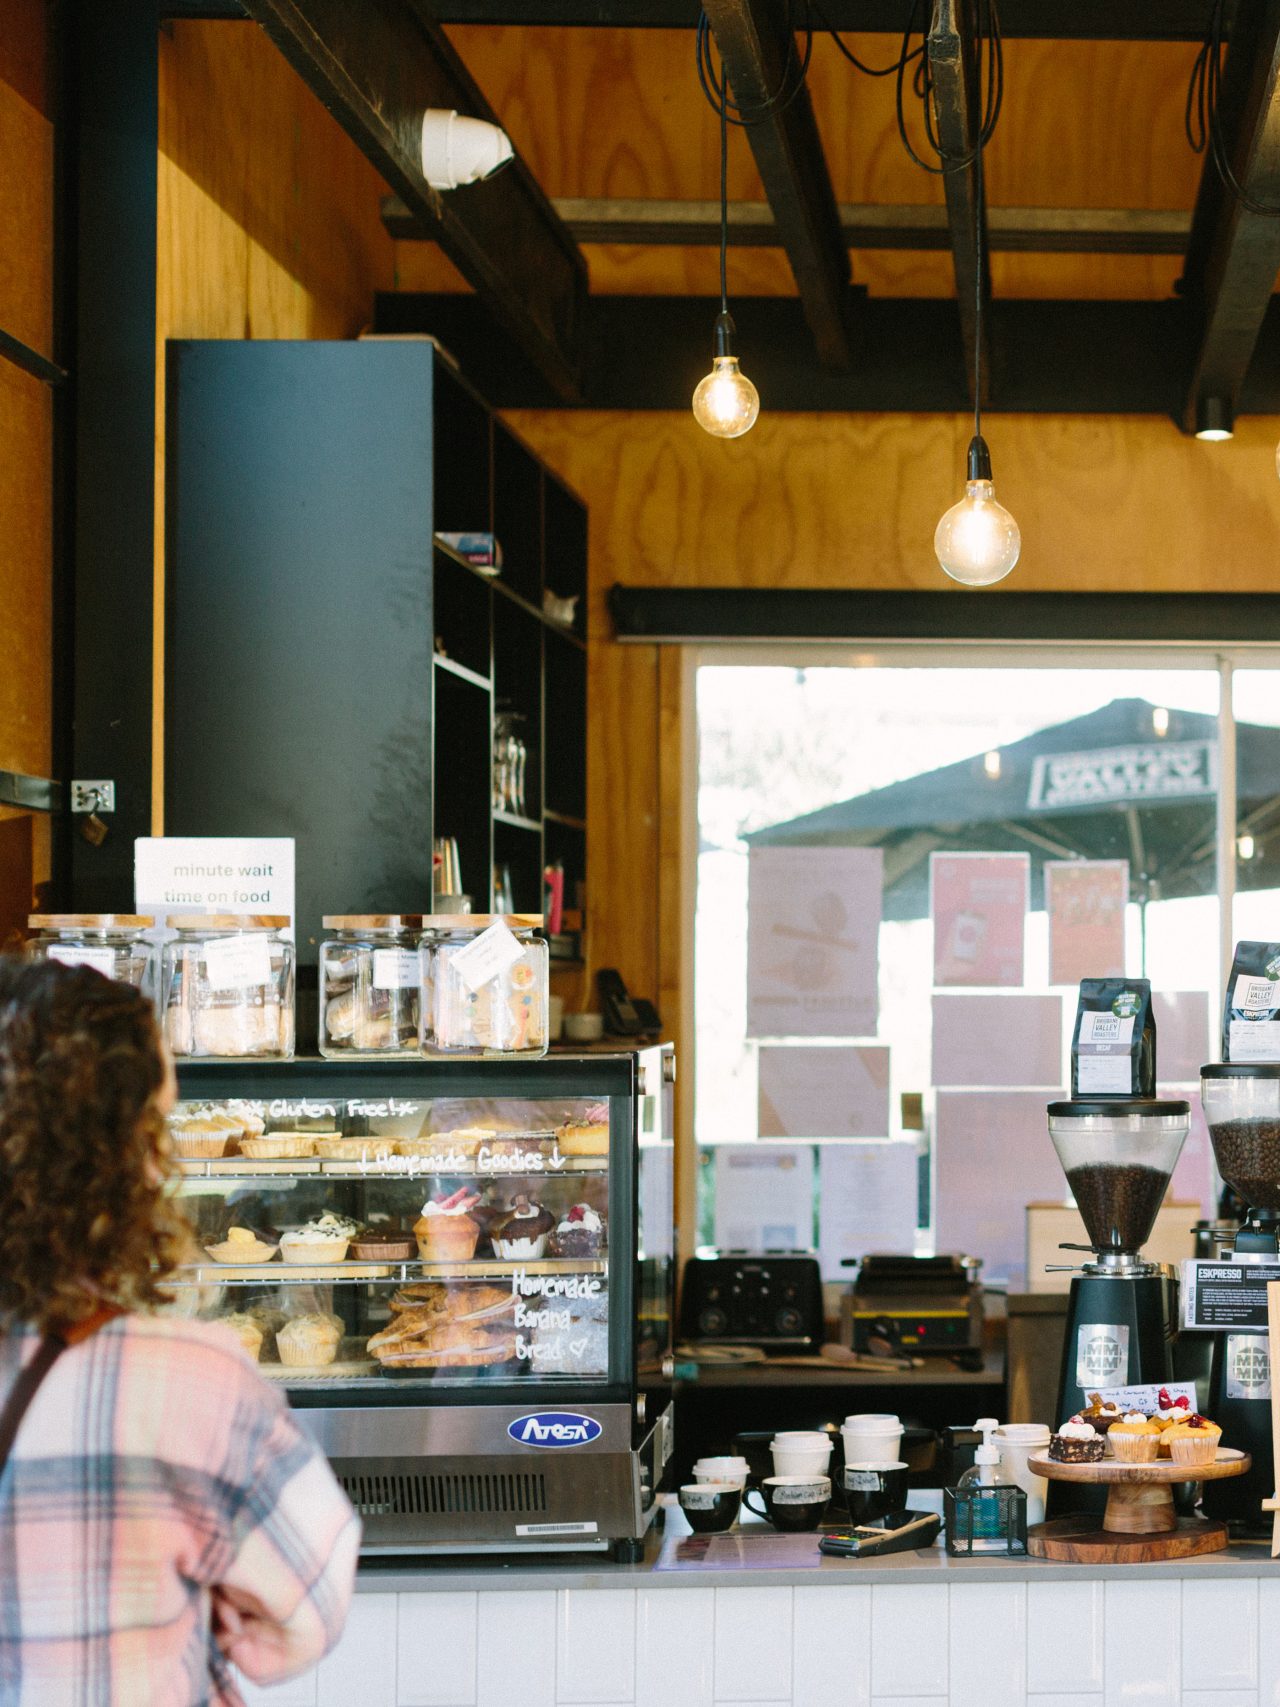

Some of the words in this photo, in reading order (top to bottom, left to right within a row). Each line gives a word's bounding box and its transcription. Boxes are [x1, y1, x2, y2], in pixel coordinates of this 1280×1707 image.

[173, 863, 234, 878] minute
[238, 863, 274, 878] wait
[164, 889, 202, 903] time
[207, 891, 228, 903] on
[232, 889, 271, 903] food
[1250, 991, 1271, 999] VALLEY
[269, 1098, 336, 1118] Gluten
[376, 1149, 467, 1175] Homemade
[478, 1147, 544, 1170] Goodies
[1198, 1268, 1242, 1279] ESKPRESSO
[512, 1268, 602, 1300] Homemade
[513, 1304, 571, 1330] Banana
[514, 1336, 564, 1361] Bread
